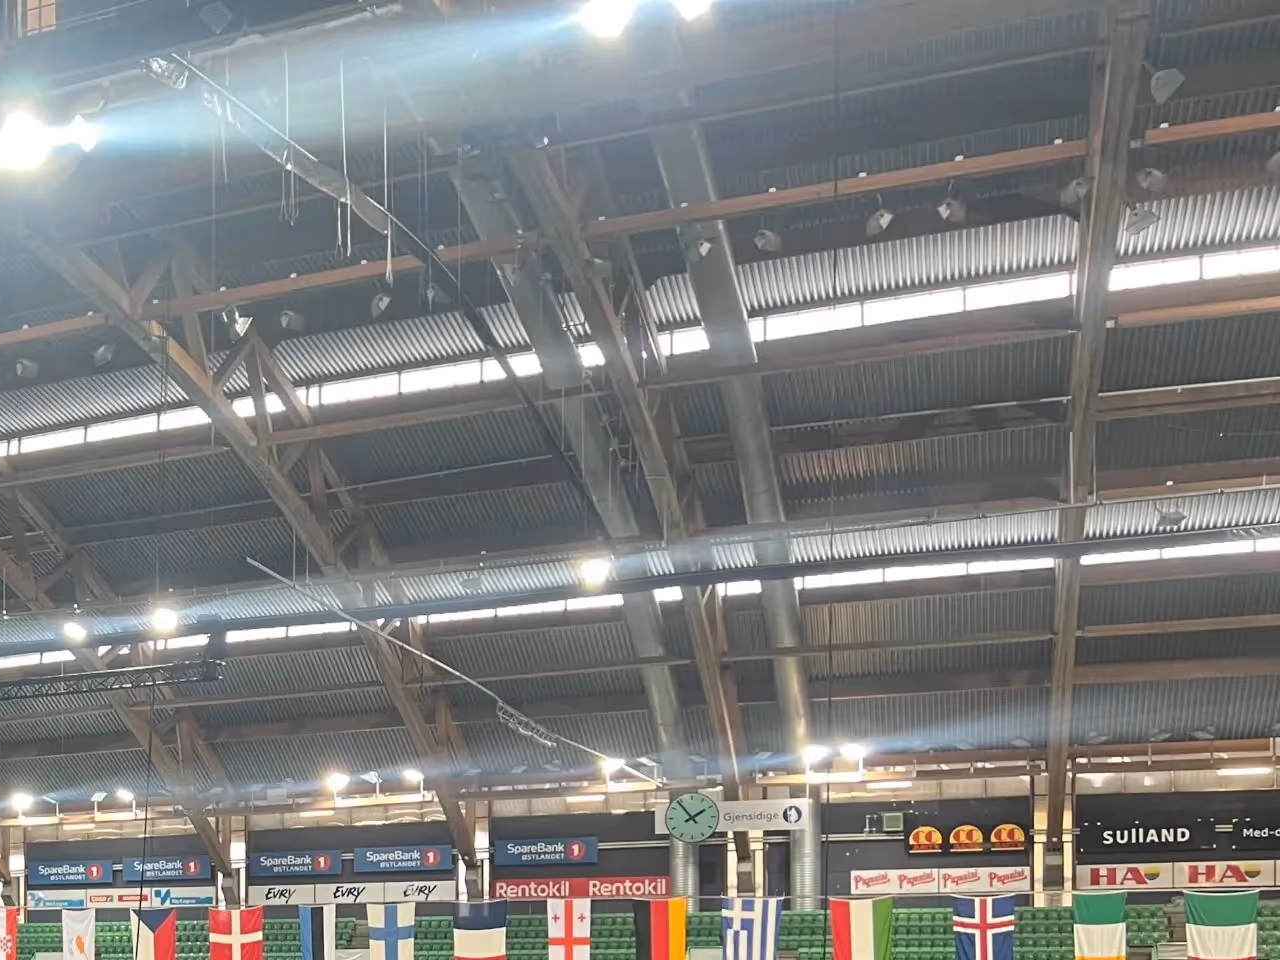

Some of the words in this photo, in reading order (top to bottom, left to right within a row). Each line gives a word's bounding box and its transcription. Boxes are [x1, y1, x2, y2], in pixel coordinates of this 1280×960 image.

[723, 811, 780, 824] Gjensidige
[507, 842, 565, 855] SpareBank
[260, 855, 312, 868] SpareBank
[366, 850, 421, 863] SpareBank
[38, 864, 86, 876] SpareBank
[133, 859, 183, 872] SpareBank
[495, 880, 570, 898] Rentokil
[588, 878, 666, 897] Rentokil
